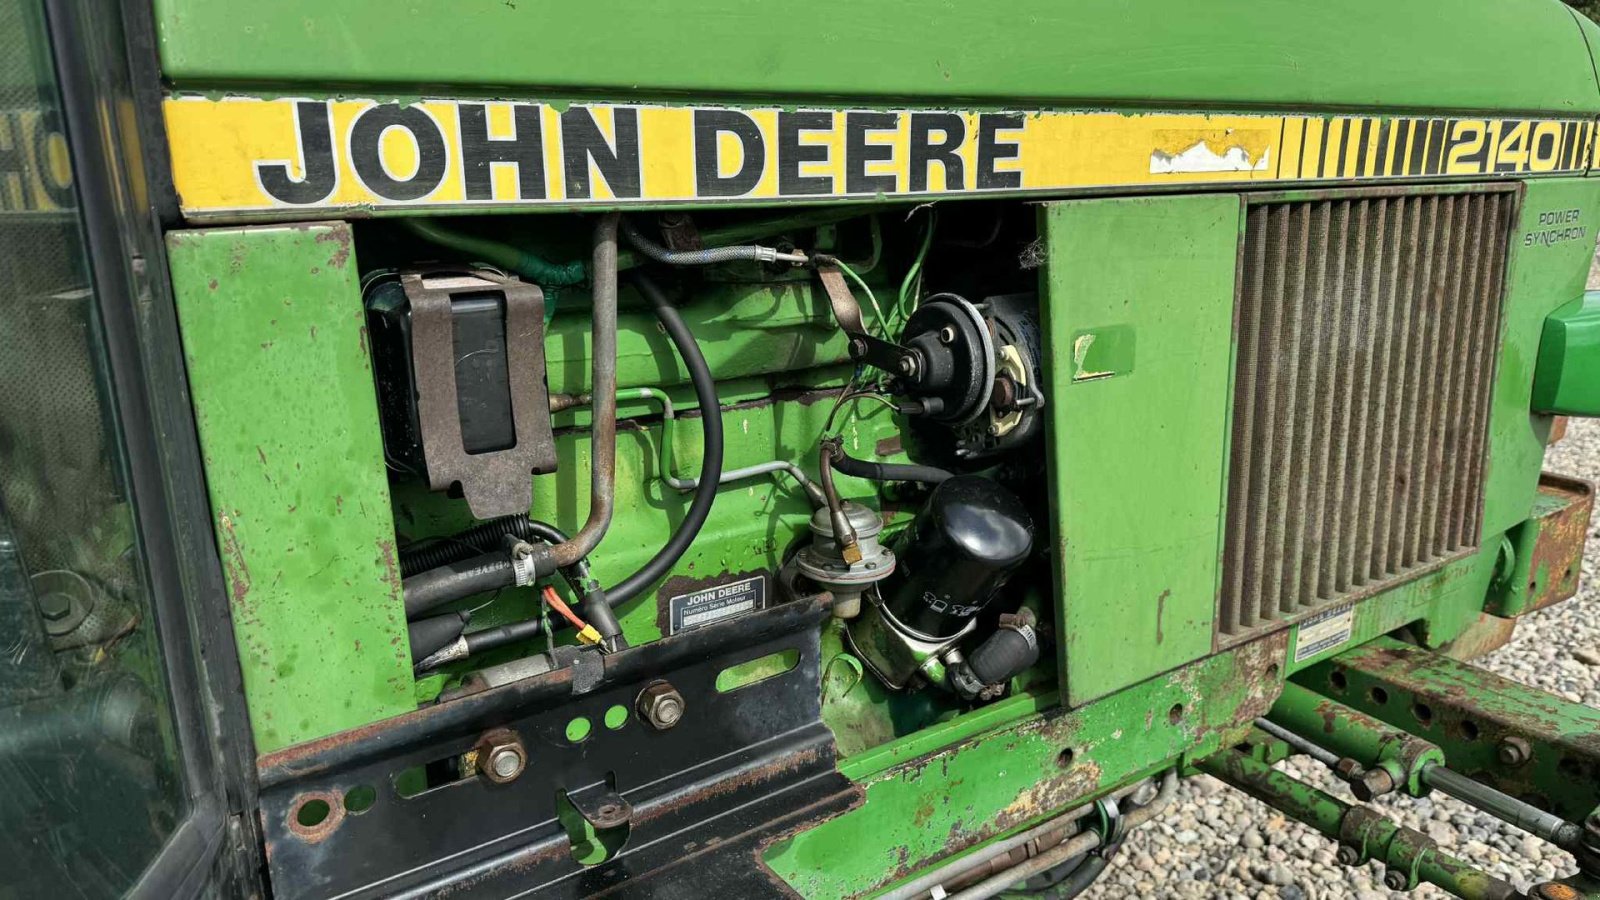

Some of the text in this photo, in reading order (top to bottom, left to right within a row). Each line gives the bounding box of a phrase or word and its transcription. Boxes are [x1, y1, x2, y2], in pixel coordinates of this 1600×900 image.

[256, 100, 1026, 205] JOHN DEERE
[1446, 119, 1563, 175] 2140
[1539, 209, 1580, 225] POWER
[1524, 227, 1586, 247] SYNCHRON
[687, 582, 751, 606] JOHN DEERE
[726, 595, 746, 605] Moteur
